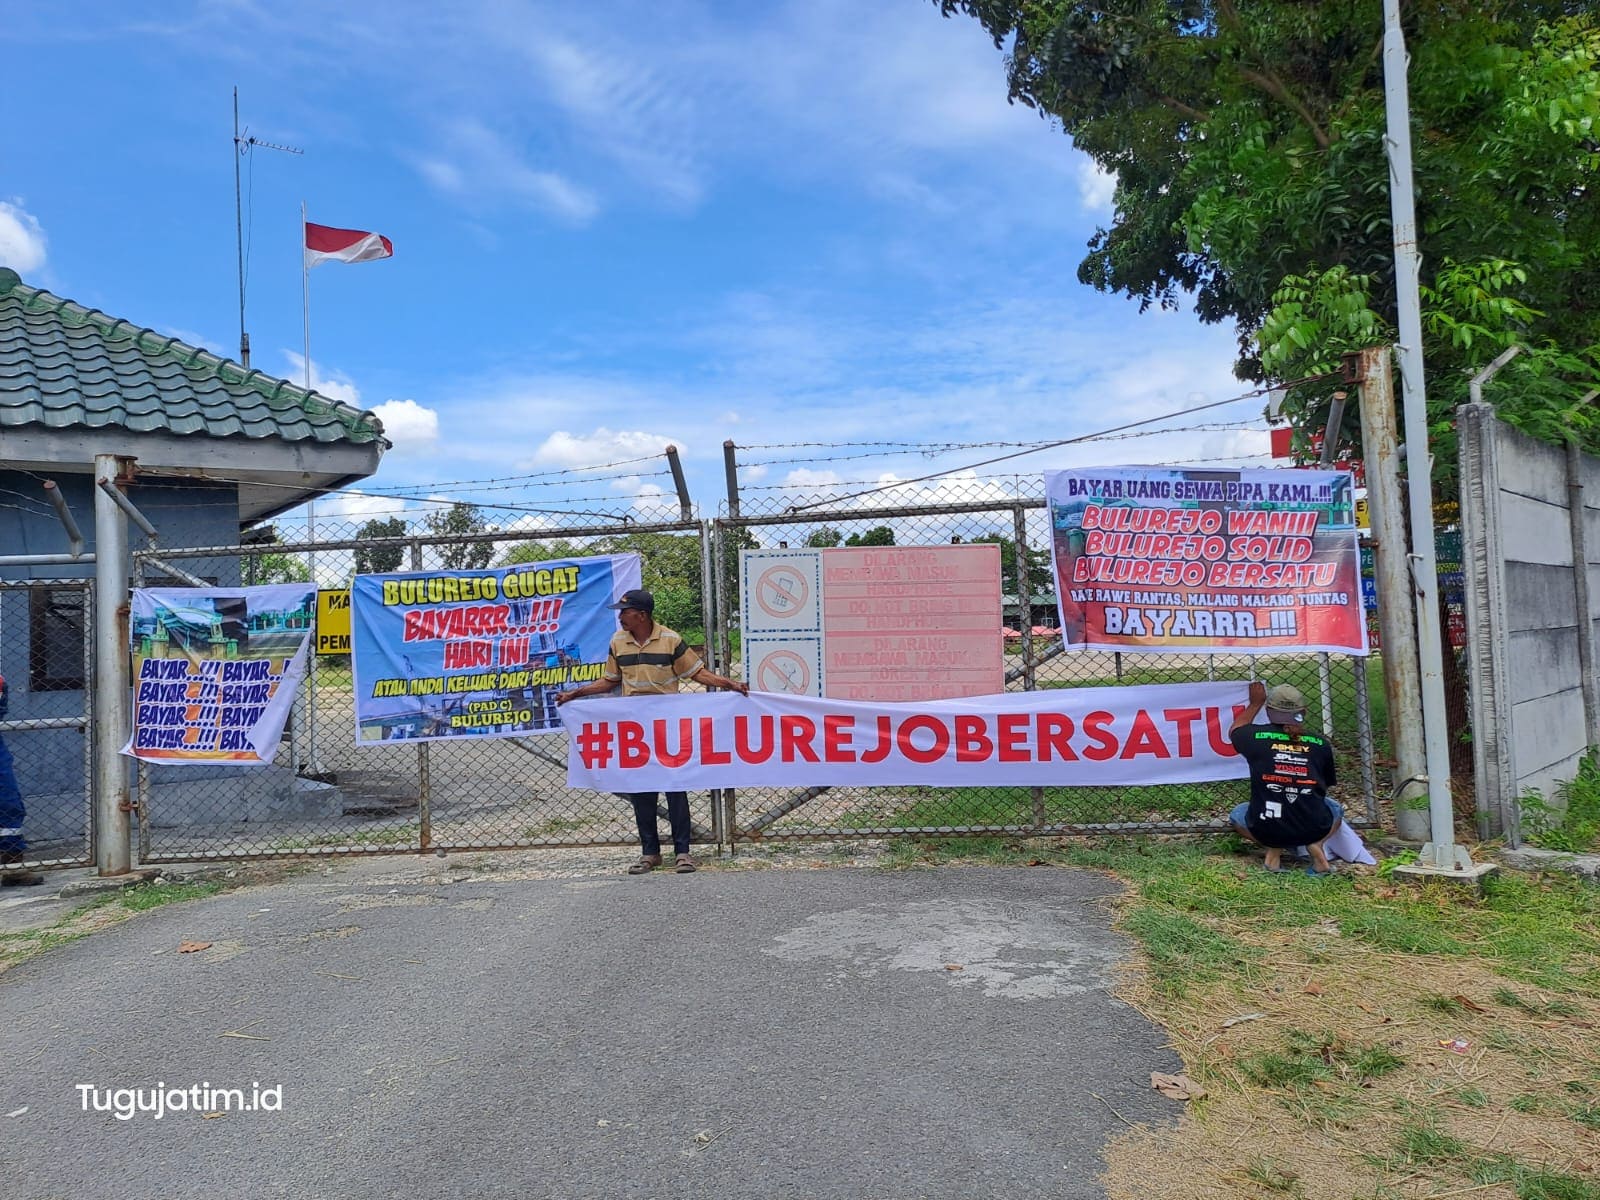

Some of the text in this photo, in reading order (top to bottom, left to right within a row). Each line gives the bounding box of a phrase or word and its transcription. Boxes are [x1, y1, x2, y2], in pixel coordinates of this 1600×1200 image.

[1069, 479, 1122, 497] BAYAR
[1127, 480, 1170, 498] UANG
[1174, 481, 1224, 500] SEWA
[1227, 481, 1264, 501] PIPA
[1082, 505, 1318, 536] BULUREJO WANIII
[1086, 530, 1313, 562] BULUREJO SOLID
[383, 566, 579, 606] BULUREJO GUGAT
[1074, 556, 1337, 587] BULUREJO BERSATU
[1096, 589, 1131, 603] RAWE
[1134, 591, 1185, 606] RANTAS,
[1187, 593, 1238, 607] MALANG
[1242, 593, 1294, 607] MALANG
[1297, 592, 1348, 606] TUNTAS
[444, 636, 529, 669] HARI INI
[373, 679, 407, 698] ATAU
[409, 676, 443, 696] ANDA
[447, 673, 499, 693] KELUAR
[499, 671, 529, 689] DARI
[532, 667, 568, 686] BUMI
[451, 709, 531, 728] BULUREJO
[468, 700, 512, 715] (PAD C)
[577, 705, 1245, 769] #BULUREJOBERSATU
